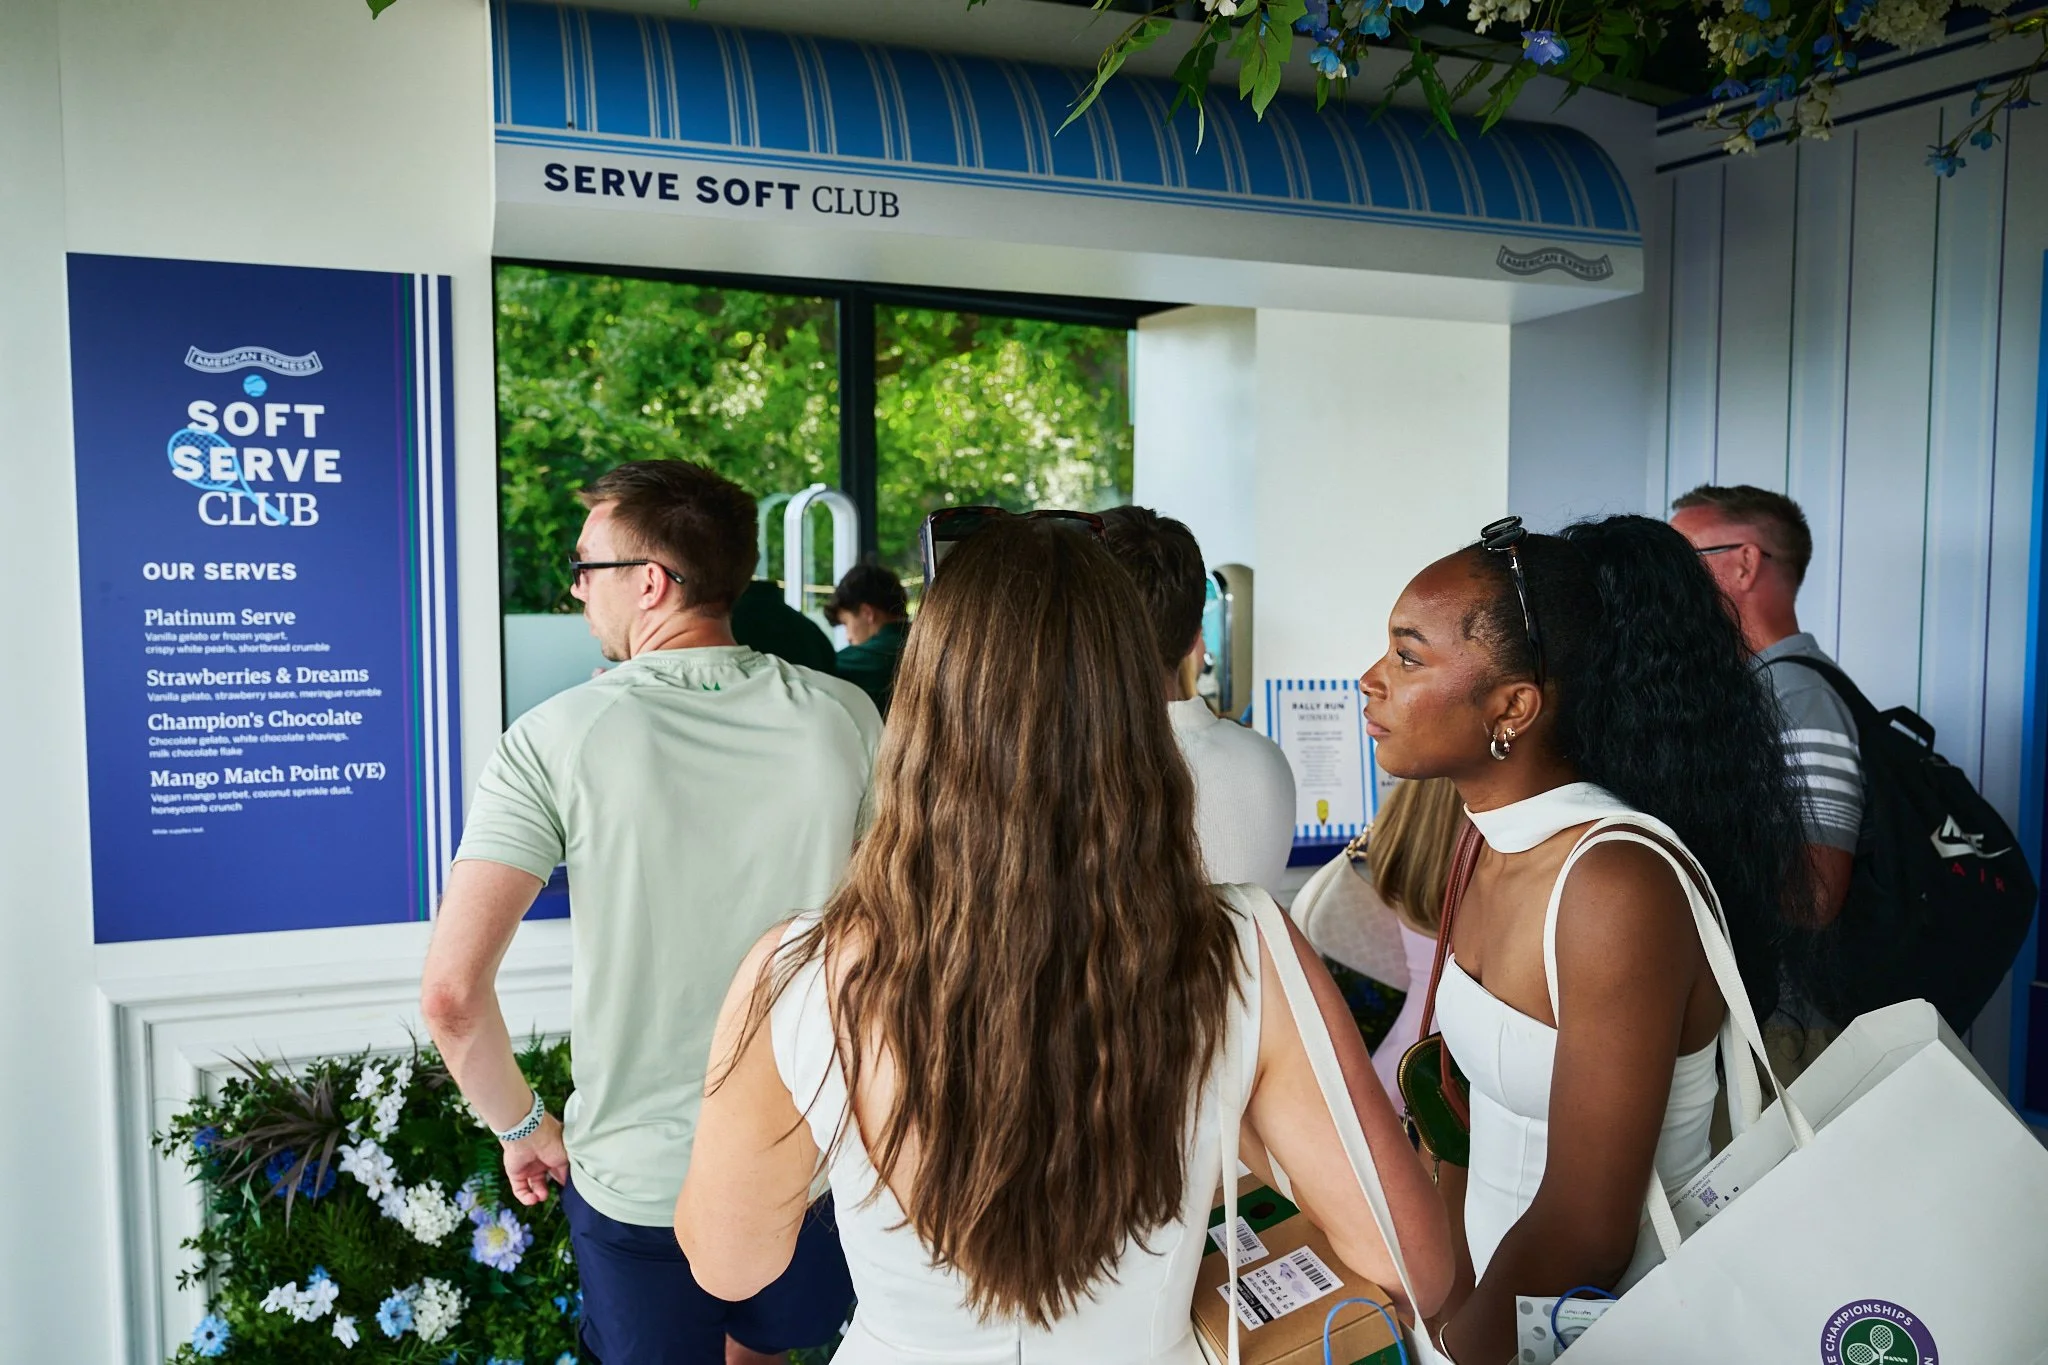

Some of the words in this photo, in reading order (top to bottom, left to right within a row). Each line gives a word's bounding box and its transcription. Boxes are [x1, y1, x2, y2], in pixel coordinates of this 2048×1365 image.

[544, 162, 680, 202] SERVE
[696, 175, 801, 210] SOFT
[811, 185, 901, 219] CLUB
[1505, 253, 1558, 268] AMERICAN
[1560, 254, 1605, 274] EXPRESS
[195, 350, 258, 368] AMERICAN
[261, 353, 312, 371] EXPRESS
[186, 400, 325, 439] SOFT
[171, 448, 342, 484] SERVE
[198, 491, 320, 528] CLUB
[143, 562, 195, 580] OUR
[204, 562, 296, 580] SERVES
[145, 609, 236, 626] Platinum
[241, 609, 296, 625] Serve
[145, 632, 177, 642] Vanilla
[179, 632, 209, 643] gelato
[210, 633, 221, 641] or
[223, 631, 252, 641] frozen
[145, 644, 175, 656] crispy
[177, 644, 203, 653] white
[239, 643, 290, 653] shortbread
[292, 643, 330, 652] crumble
[147, 668, 271, 686] Strawberries
[276, 667, 291, 684] &
[296, 667, 369, 683] Dreams
[148, 692, 179, 702] Vanilla
[215, 691, 266, 702] strawberry
[300, 689, 342, 700] meringue
[344, 688, 382, 698] crumble
[1292, 702, 1321, 710] RALLY
[1324, 702, 1345, 710] RUN
[148, 712, 264, 733] Champion's
[268, 709, 362, 728] Chocolate
[149, 736, 197, 746] Chocolate
[233, 734, 258, 744] white
[260, 733, 305, 743] chocolate
[150, 749, 169, 758] milk
[171, 748, 218, 758] chocolate
[220, 747, 243, 756] flake
[150, 770, 219, 789] Mango
[224, 766, 284, 785] Match
[289, 764, 340, 782] Point
[344, 762, 386, 781] (VE)
[151, 793, 181, 804] Vegan
[183, 792, 216, 803] mango
[253, 789, 290, 798] coconut
[292, 787, 328, 798] sprinkle
[152, 804, 207, 814] honeycomb
[209, 802, 242, 812] crunch
[1692, 1170, 1713, 1190] WIMBLEDON
[1713, 1154, 1731, 1170] MOMENTS
[1691, 1188, 1702, 1198] SCAN
[1826, 1304, 1913, 1352] CHAMPIONSHIPS
